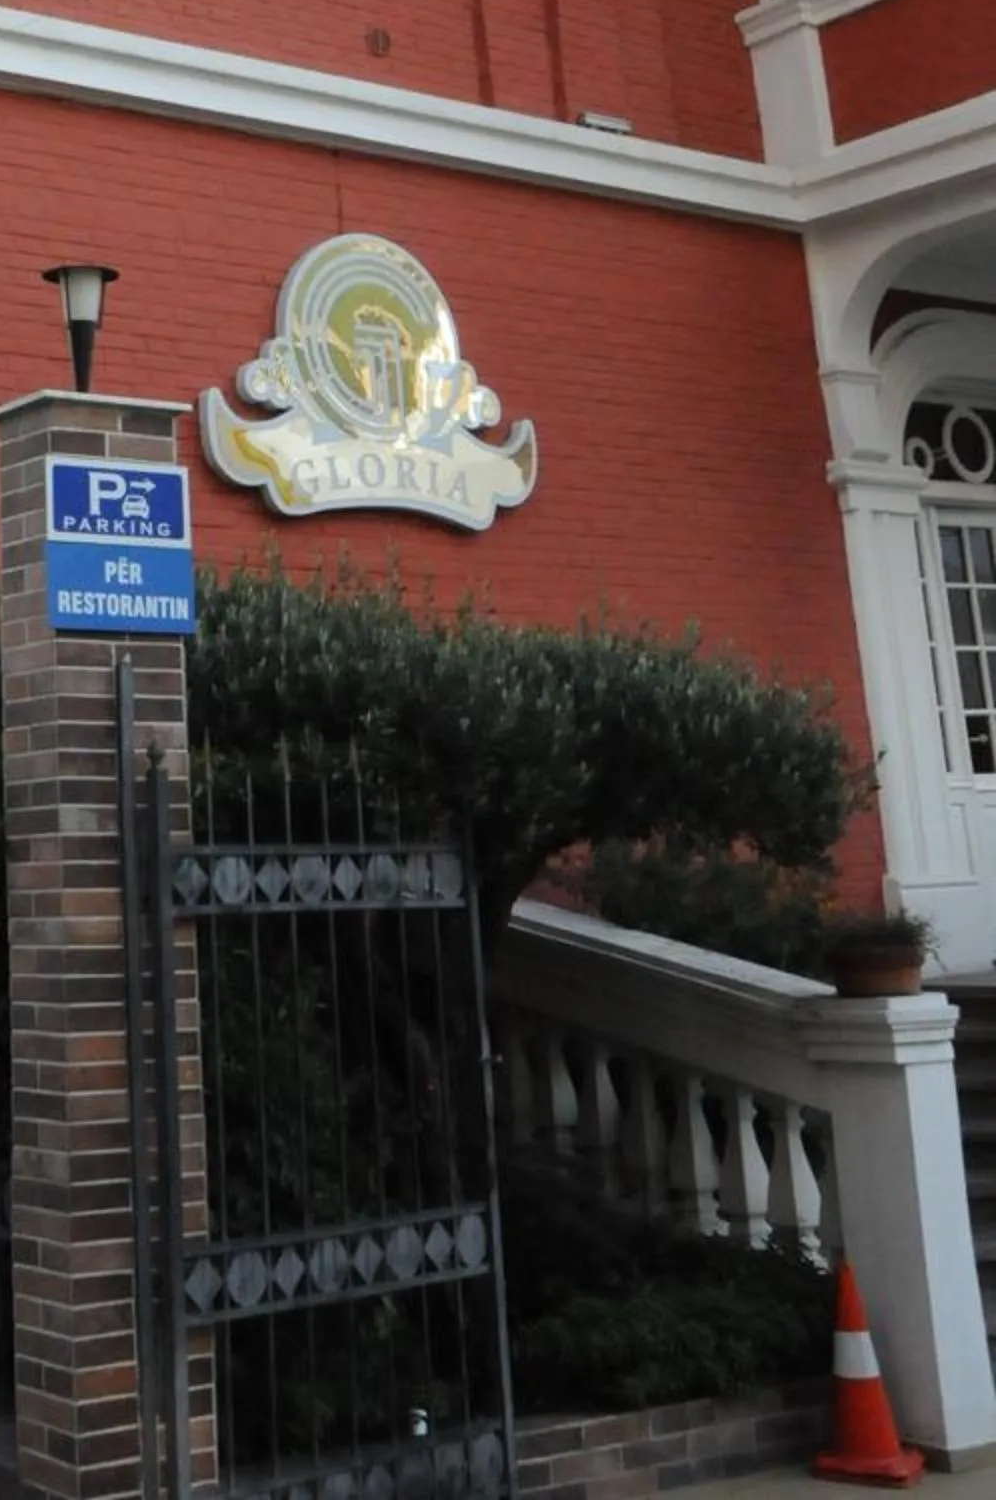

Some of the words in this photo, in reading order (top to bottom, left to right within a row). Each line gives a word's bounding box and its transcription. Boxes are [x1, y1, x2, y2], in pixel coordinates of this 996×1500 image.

[88, 471, 127, 517] P
[291, 453, 472, 508] GLORIA
[62, 515, 172, 537] PARKING
[104, 556, 143, 585] PËR
[57, 590, 189, 620] RESTORANTIN
